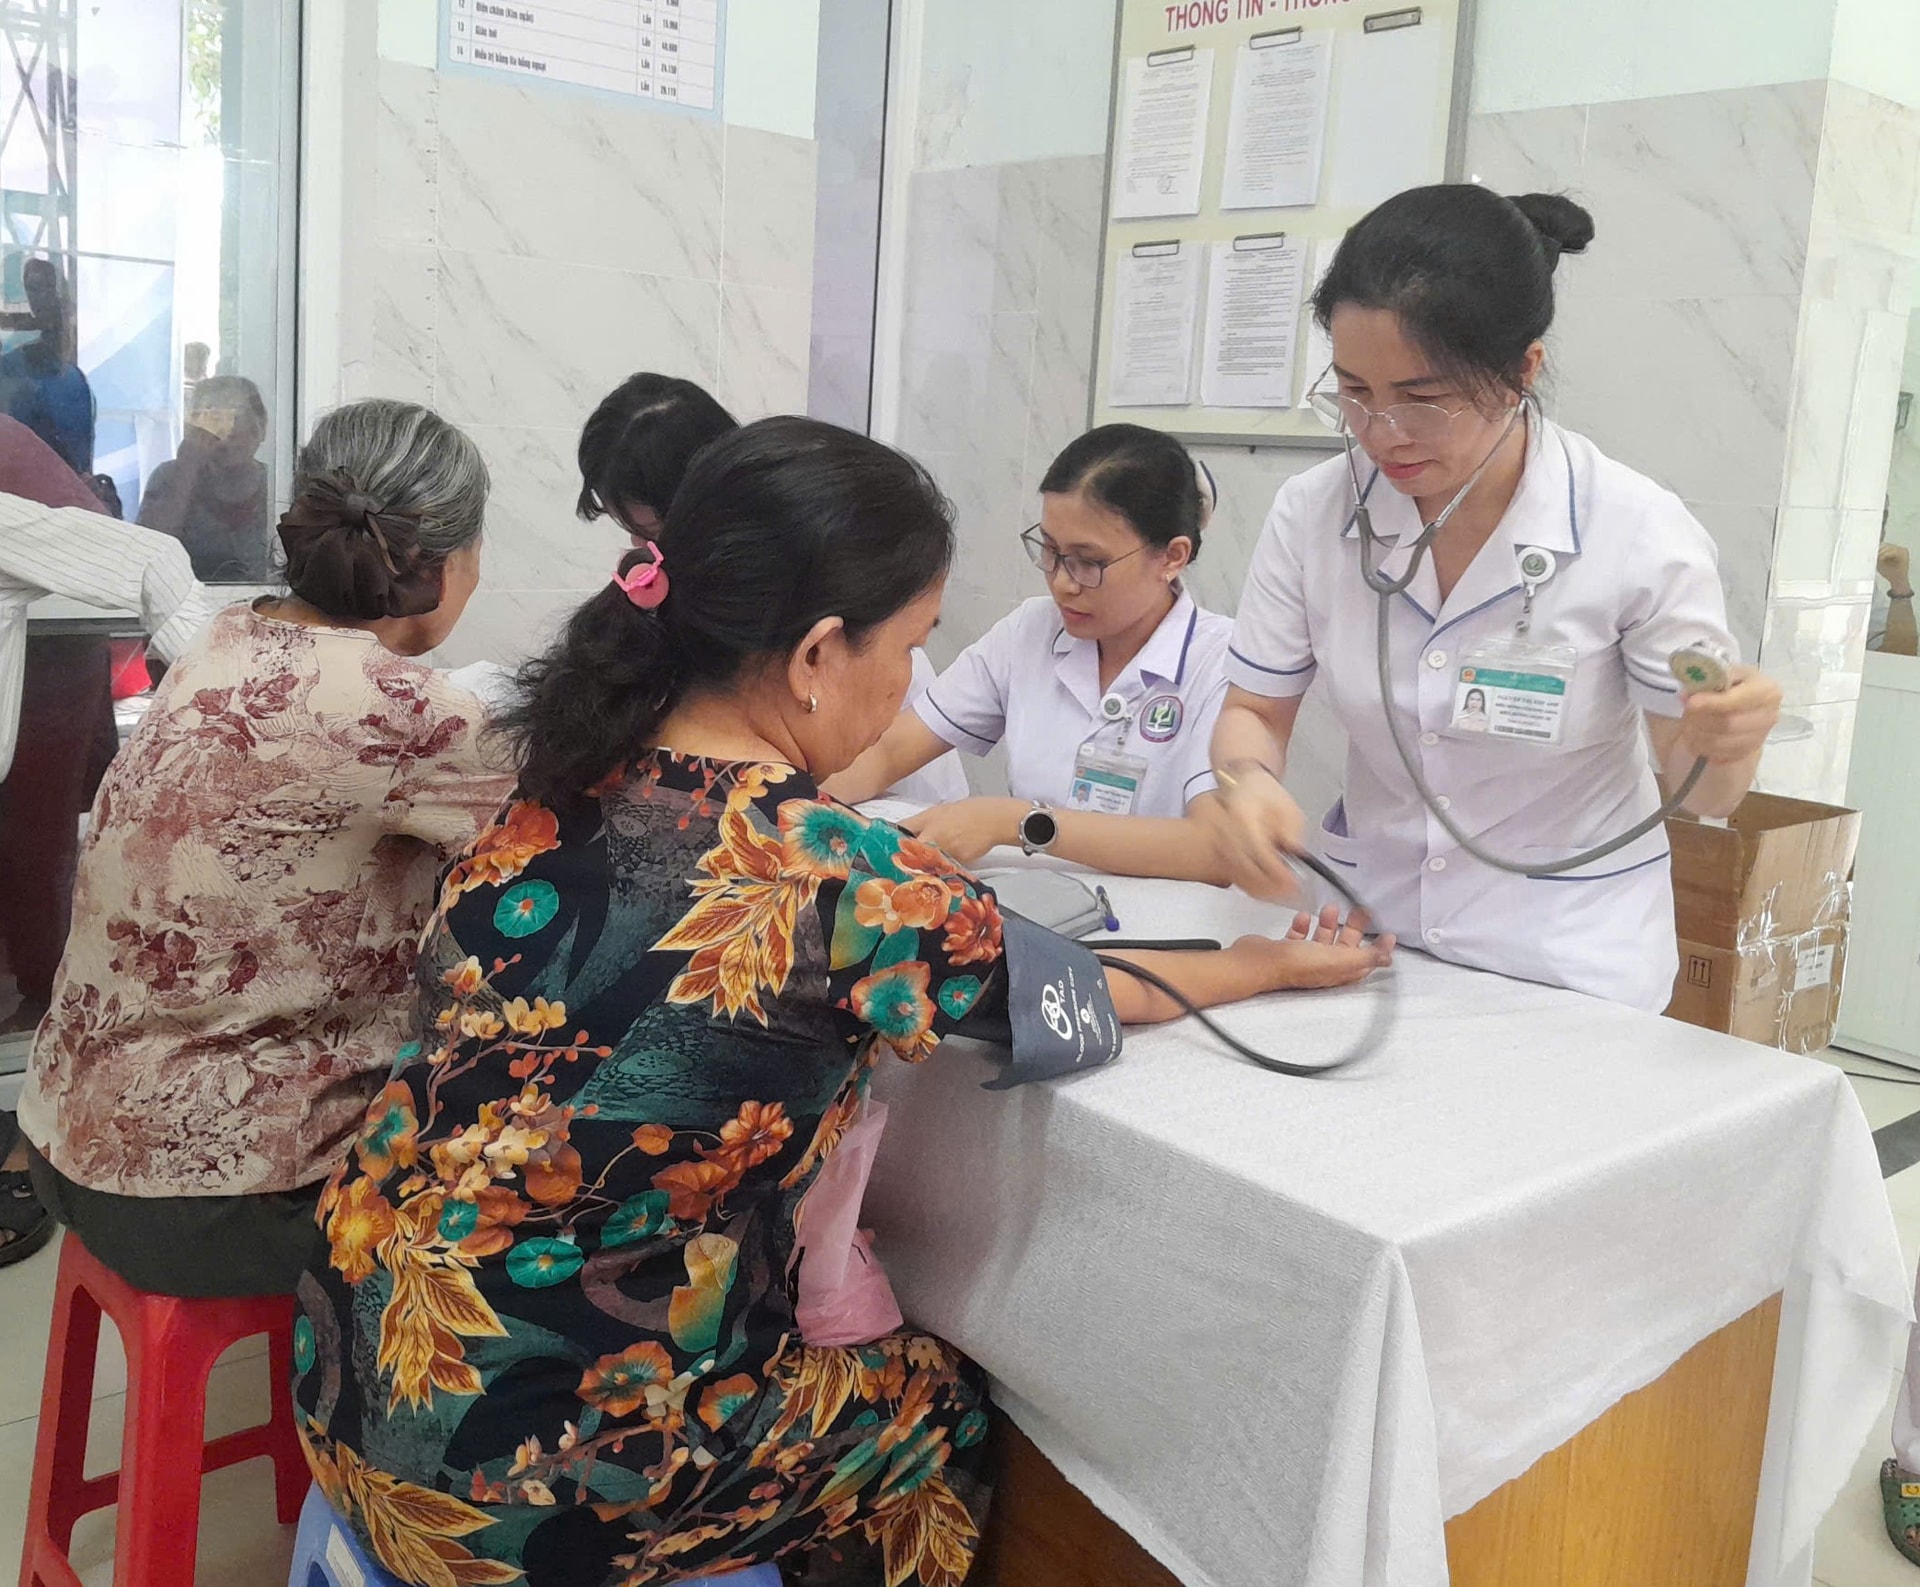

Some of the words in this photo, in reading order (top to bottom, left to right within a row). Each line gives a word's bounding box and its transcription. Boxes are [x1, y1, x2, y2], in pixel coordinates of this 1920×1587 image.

[1067, 966, 1075, 988] CUFF
[1071, 988, 1082, 1032] PRESSURE
[1075, 1033, 1085, 1063] BLOOD
